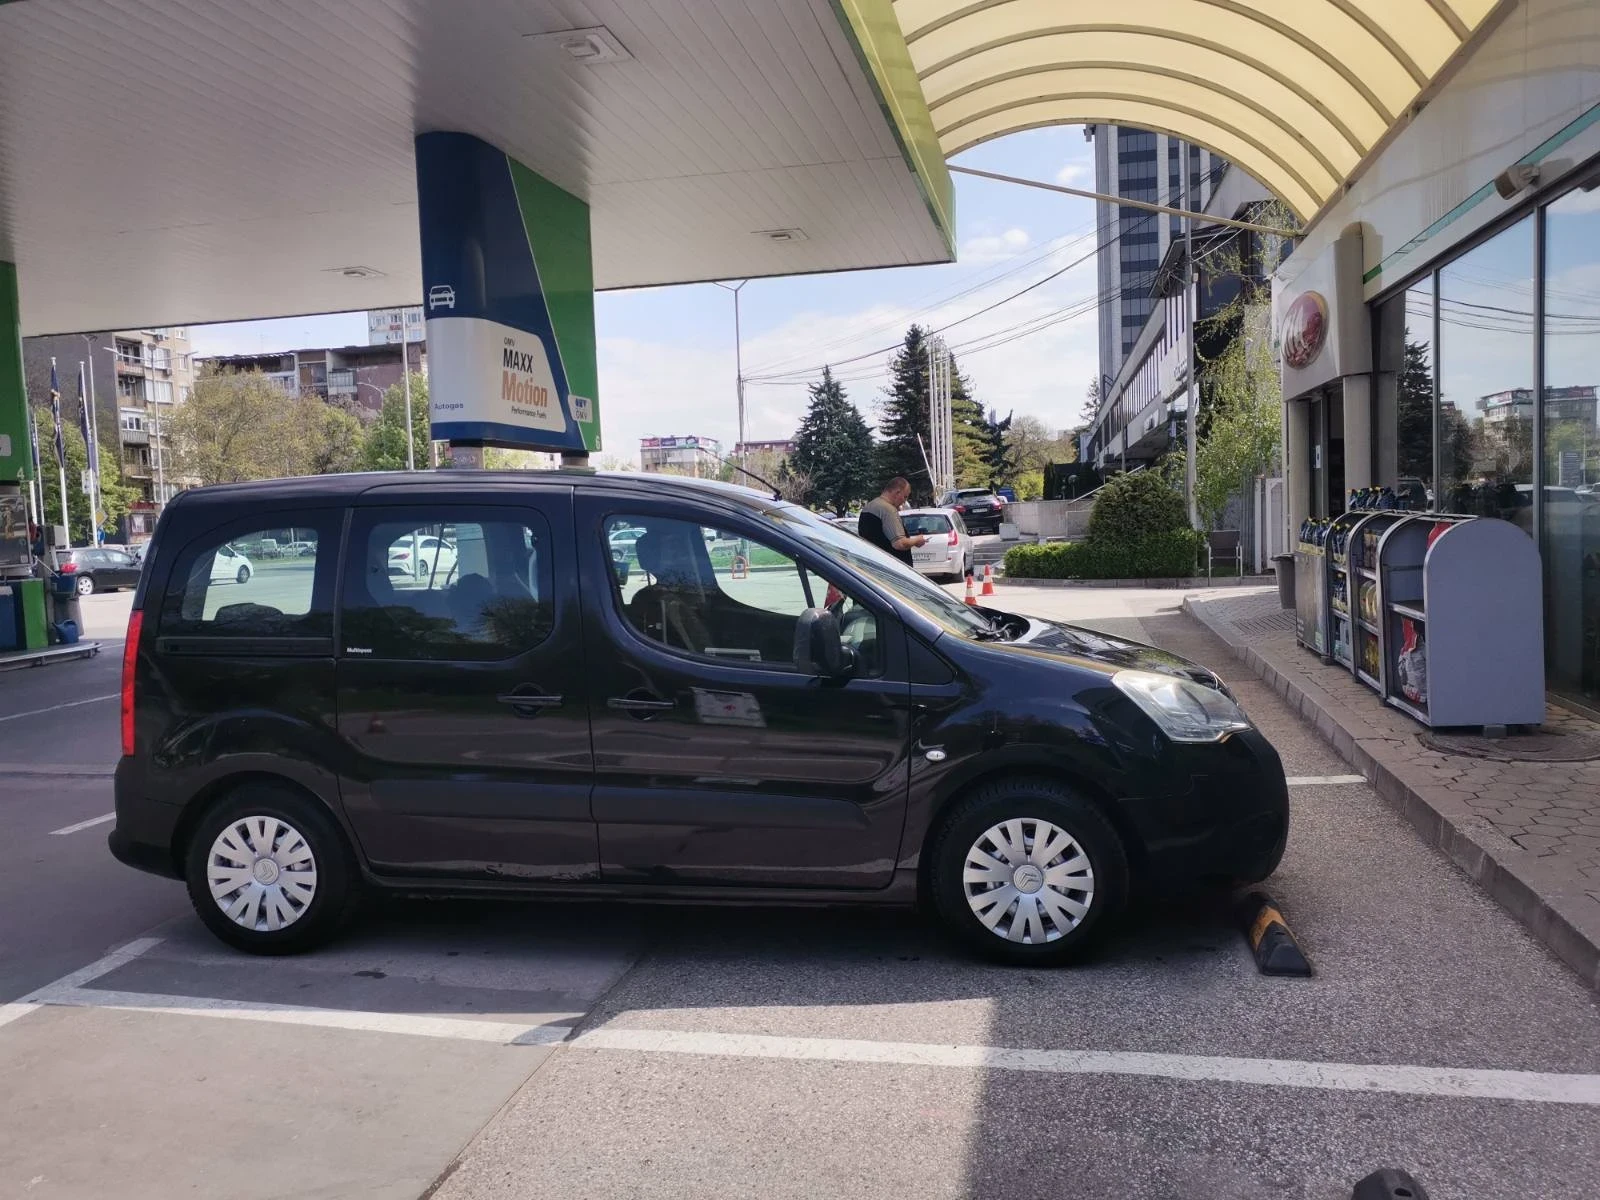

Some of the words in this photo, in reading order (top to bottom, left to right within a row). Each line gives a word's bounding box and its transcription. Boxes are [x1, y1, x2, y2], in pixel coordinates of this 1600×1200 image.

[503, 348, 533, 373] MAXX
[502, 371, 548, 407] Motion
[17, 466, 25, 480] 4
